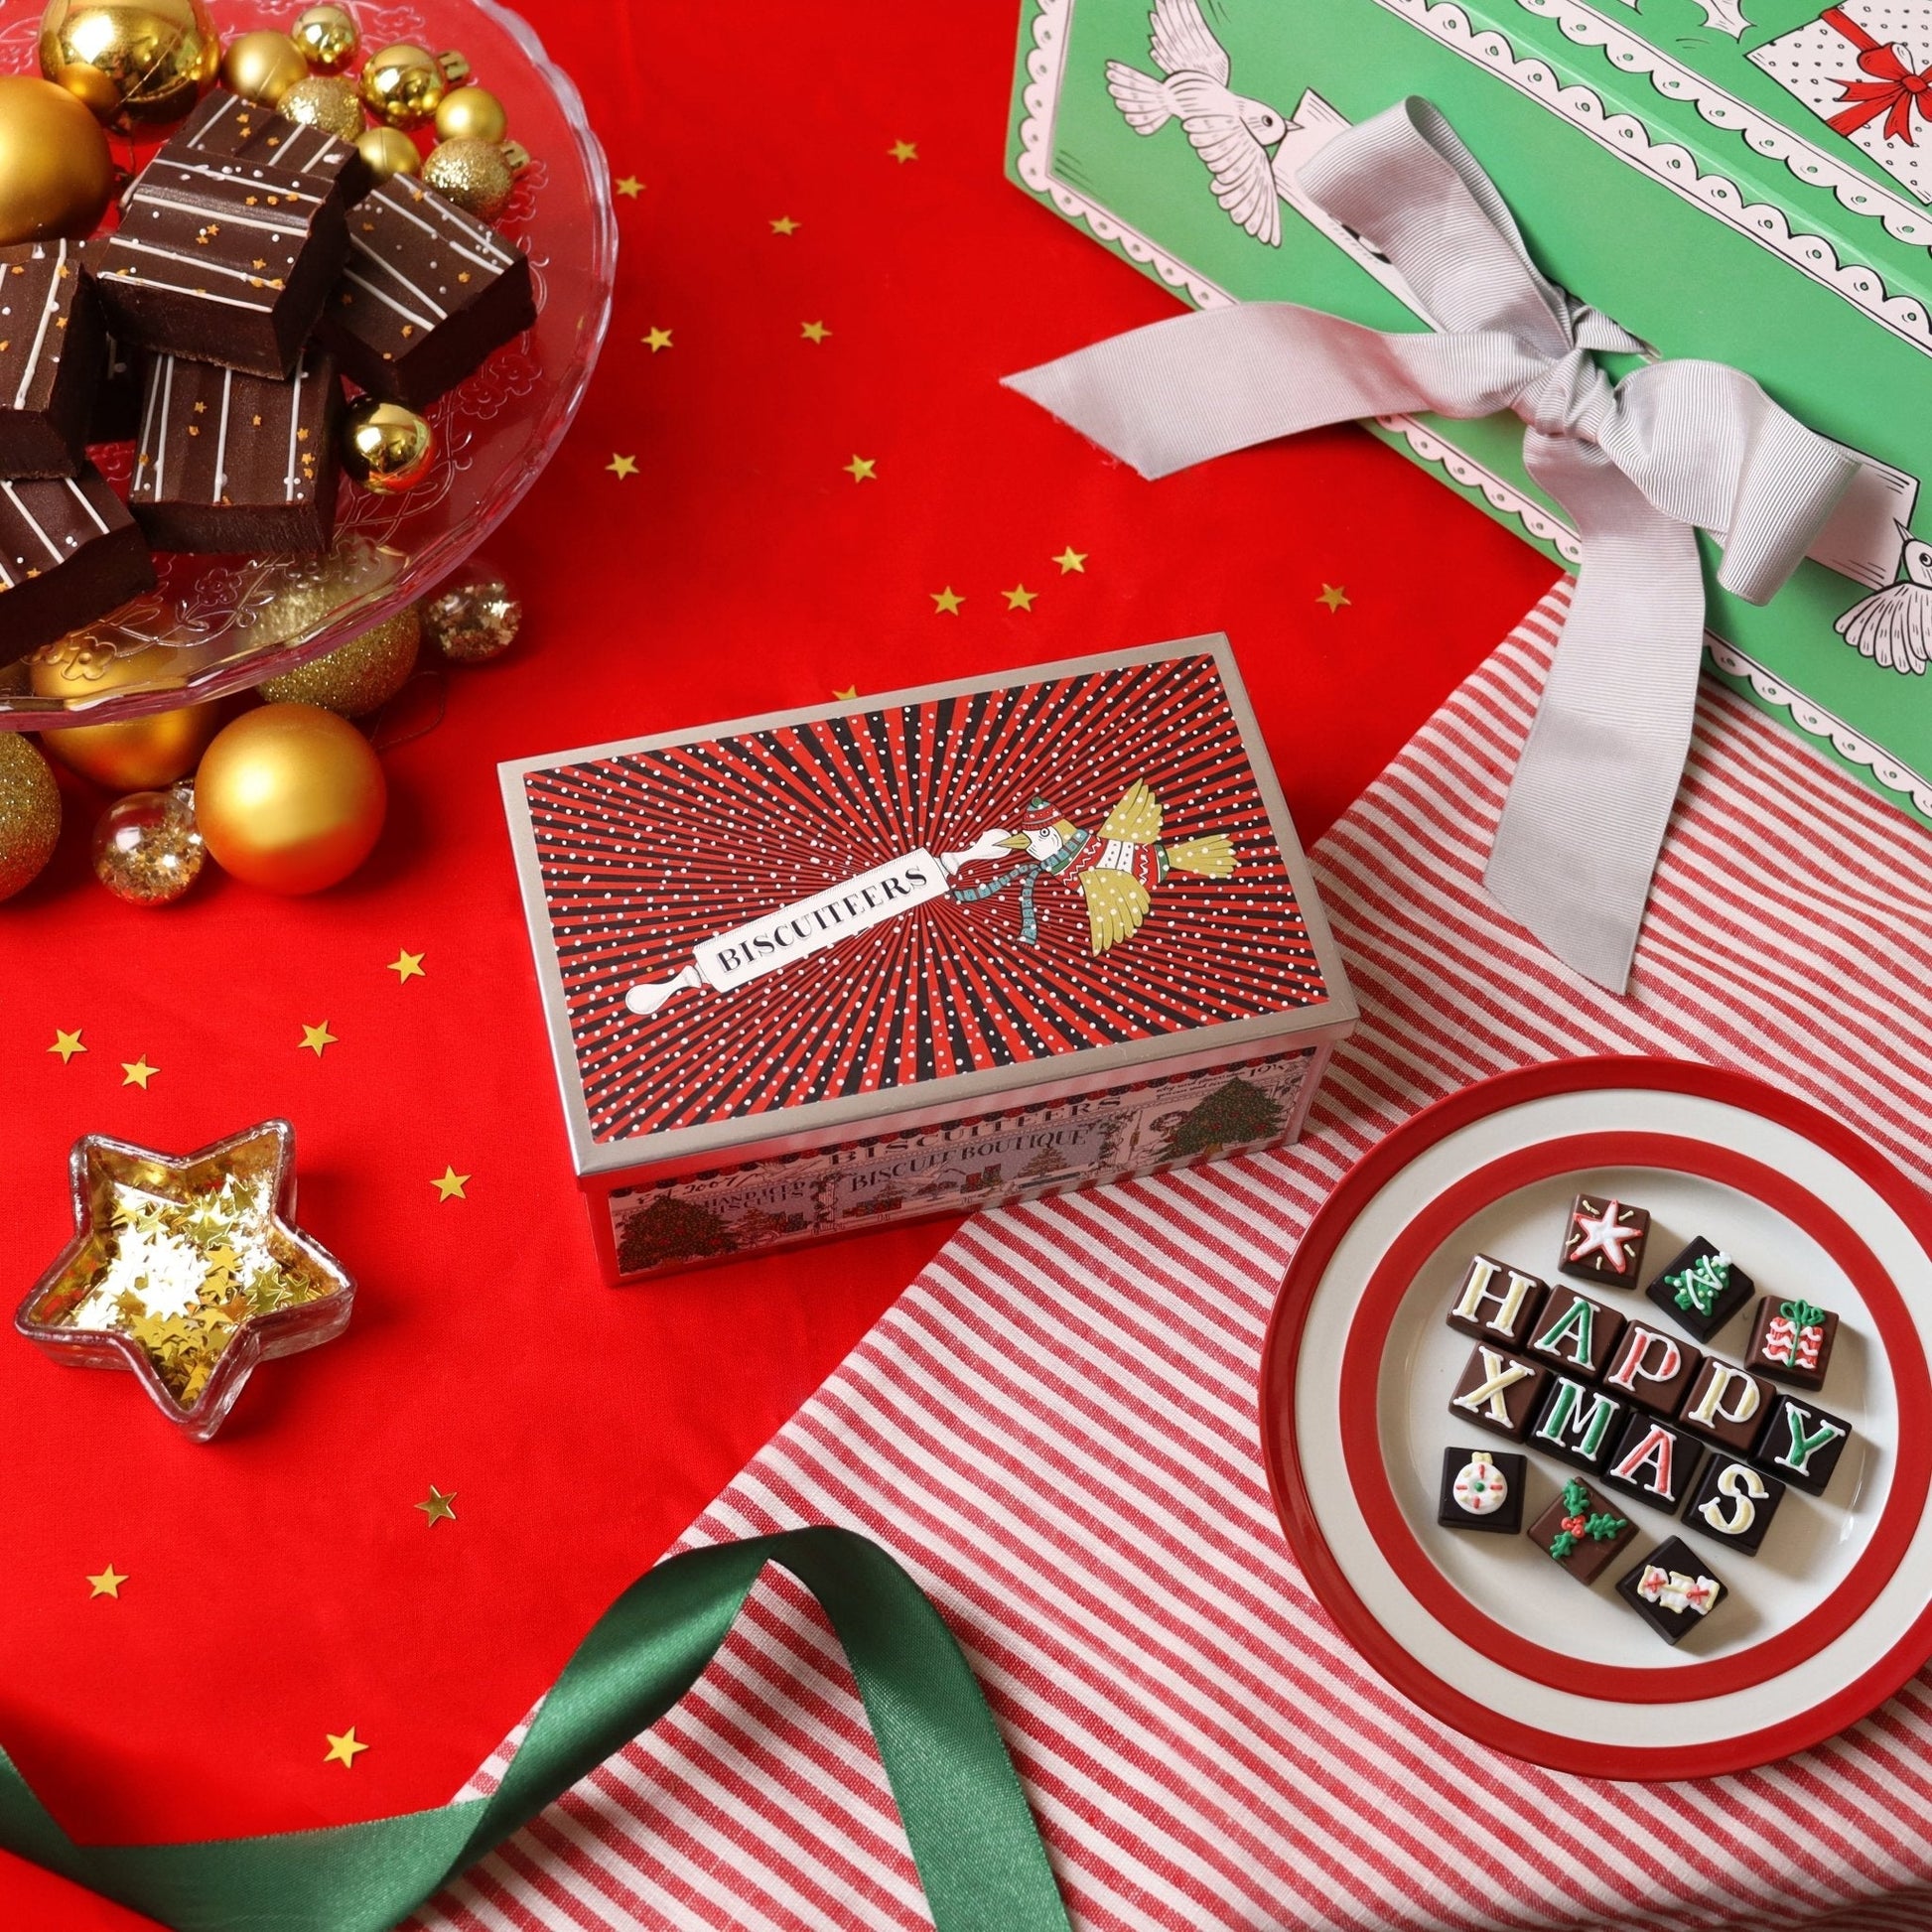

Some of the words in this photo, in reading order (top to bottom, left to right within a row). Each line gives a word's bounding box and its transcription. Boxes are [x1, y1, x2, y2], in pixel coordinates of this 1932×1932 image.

[714, 866, 928, 974] BISCUITEERS
[828, 1096, 1121, 1166] BISCUITEERS
[851, 1148, 956, 1191] BISCUIT
[960, 1129, 1090, 1162] BOUTIQUE
[682, 1175, 740, 1195] 2007
[704, 1191, 757, 1208] HAND
[760, 1181, 806, 1197] ICED
[1450, 1252, 1846, 1477] HAPPY
[1452, 1344, 1770, 1535] XMAS
